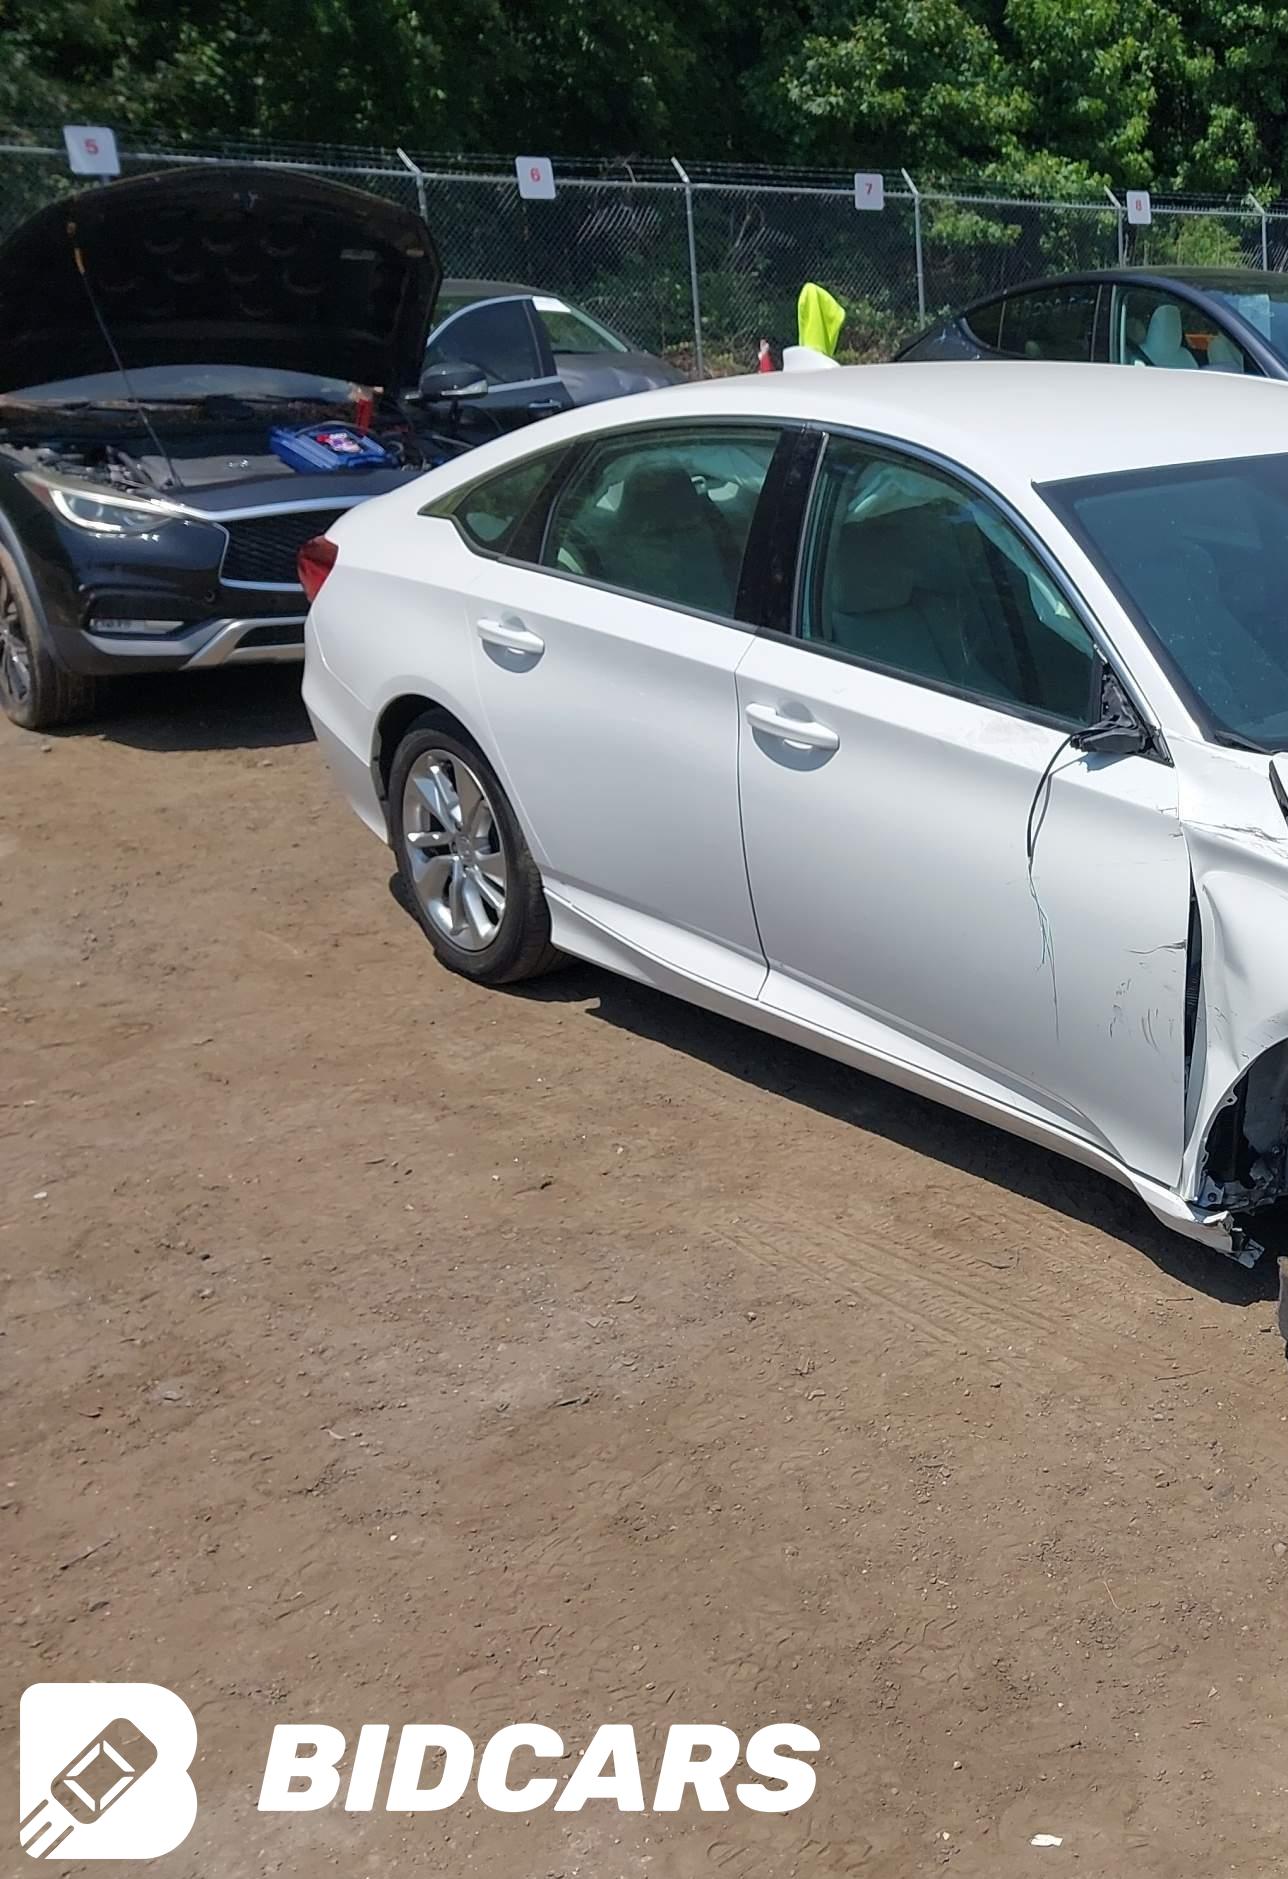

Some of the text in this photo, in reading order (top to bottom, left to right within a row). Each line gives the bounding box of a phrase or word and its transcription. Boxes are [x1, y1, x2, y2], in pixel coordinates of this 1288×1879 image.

[84, 138, 99, 155] 5
[530, 167, 541, 183] 6
[864, 183, 873, 196] 7
